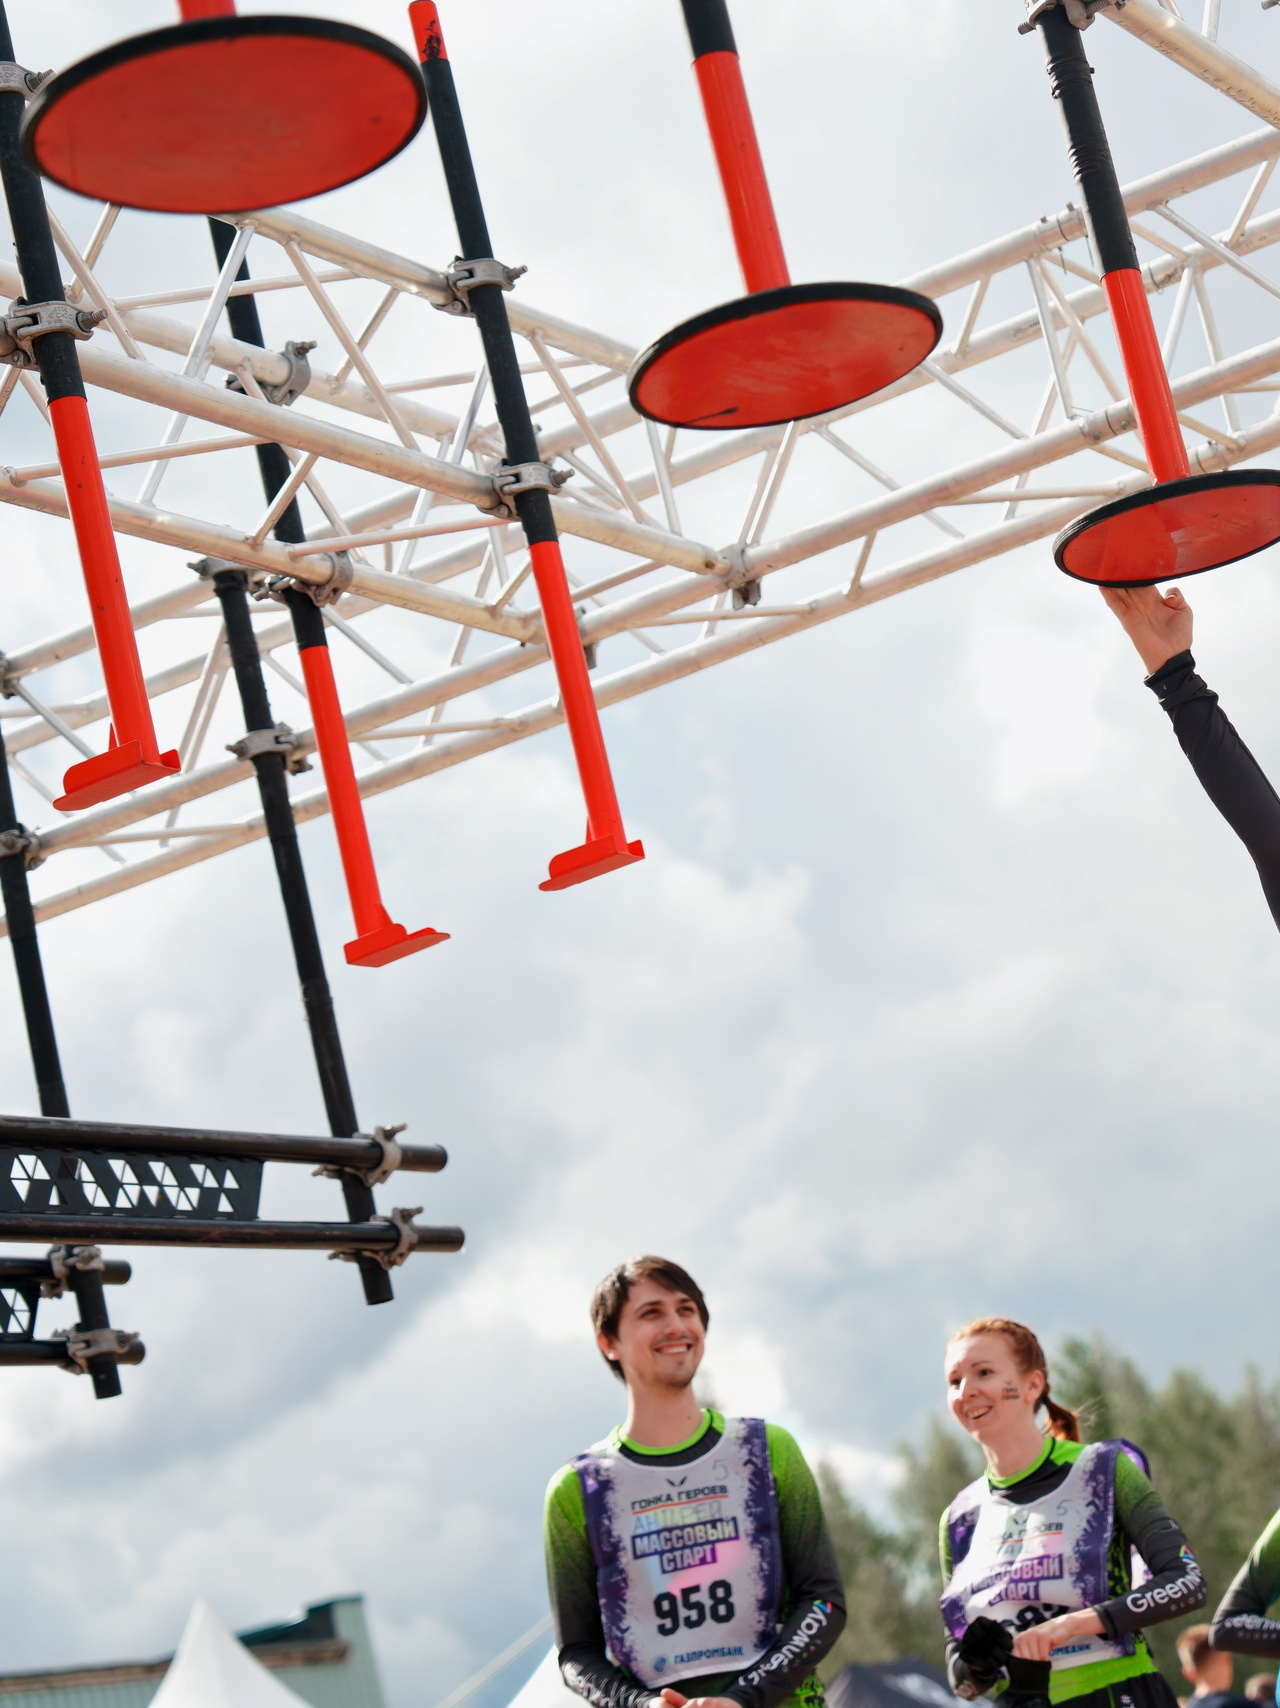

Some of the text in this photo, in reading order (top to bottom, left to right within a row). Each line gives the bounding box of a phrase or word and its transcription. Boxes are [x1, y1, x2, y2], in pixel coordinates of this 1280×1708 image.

[631, 1485, 728, 1511] ГОНКА ГЕРОЕВ
[634, 1518, 736, 1556] МАССОВЫЙ
[662, 1544, 714, 1571] СТАРТ
[653, 1580, 736, 1637] 958
[674, 1646, 743, 1665] ГАЗПРОМБАНК
